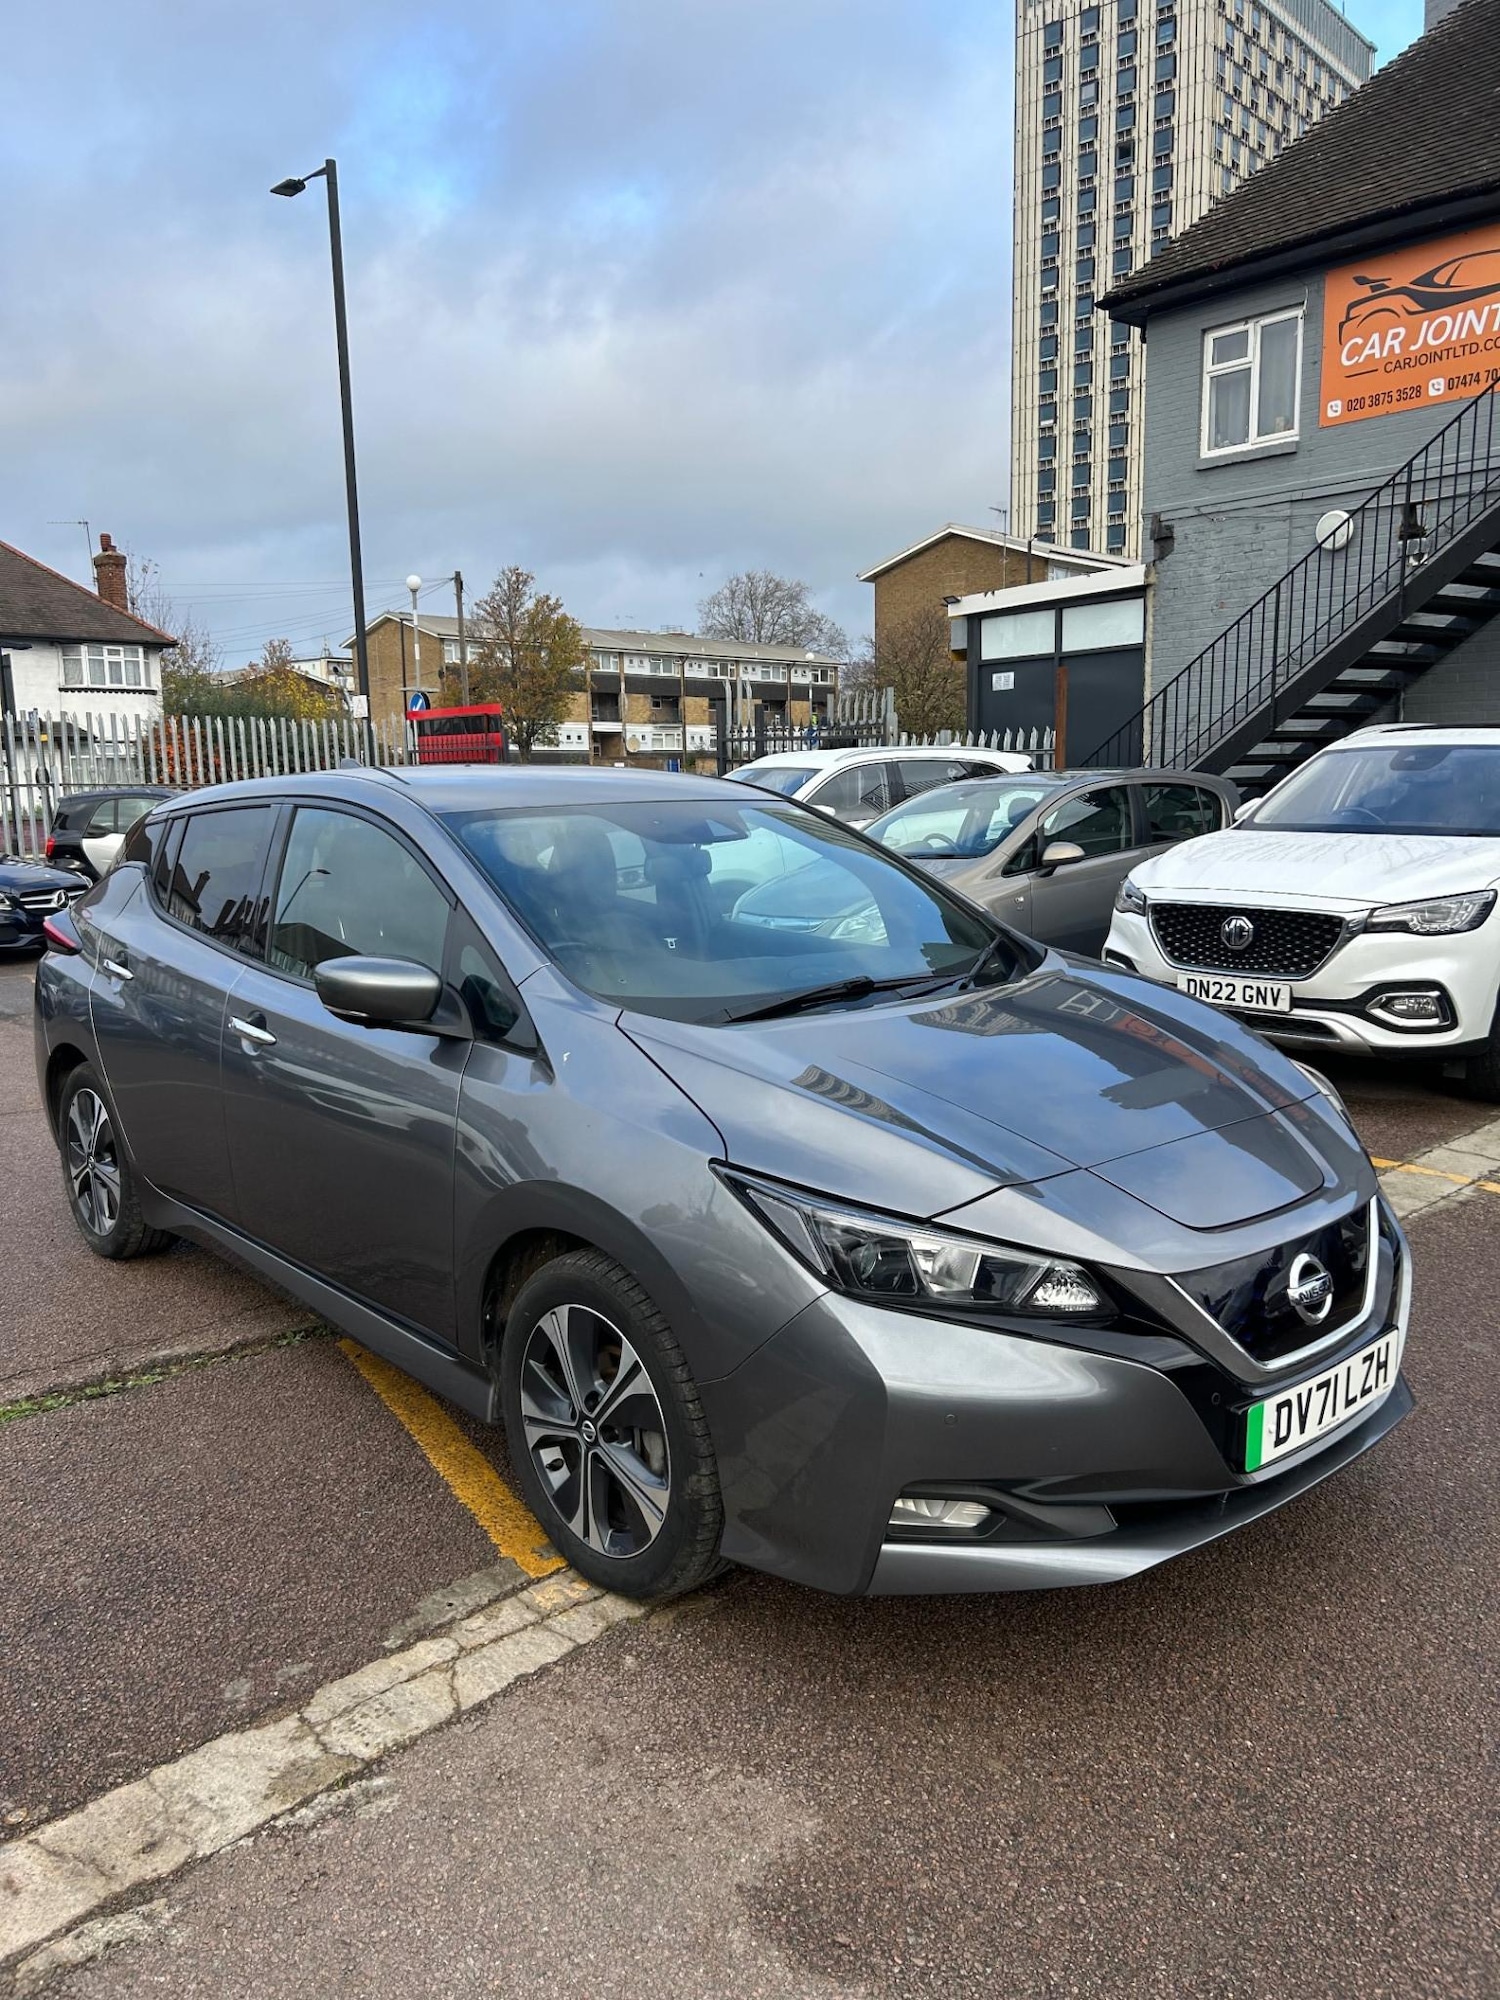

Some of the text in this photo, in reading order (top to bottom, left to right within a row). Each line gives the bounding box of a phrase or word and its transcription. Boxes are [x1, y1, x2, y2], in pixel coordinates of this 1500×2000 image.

[1341, 303, 1500, 366] CAR JOINT
[1448, 367, 1500, 390] 07474 70
[1347, 385, 1422, 412] 020 3875 3528
[1186, 978, 1281, 1007] DN22 GNV
[1273, 1341, 1390, 1449] DV71 LZH
